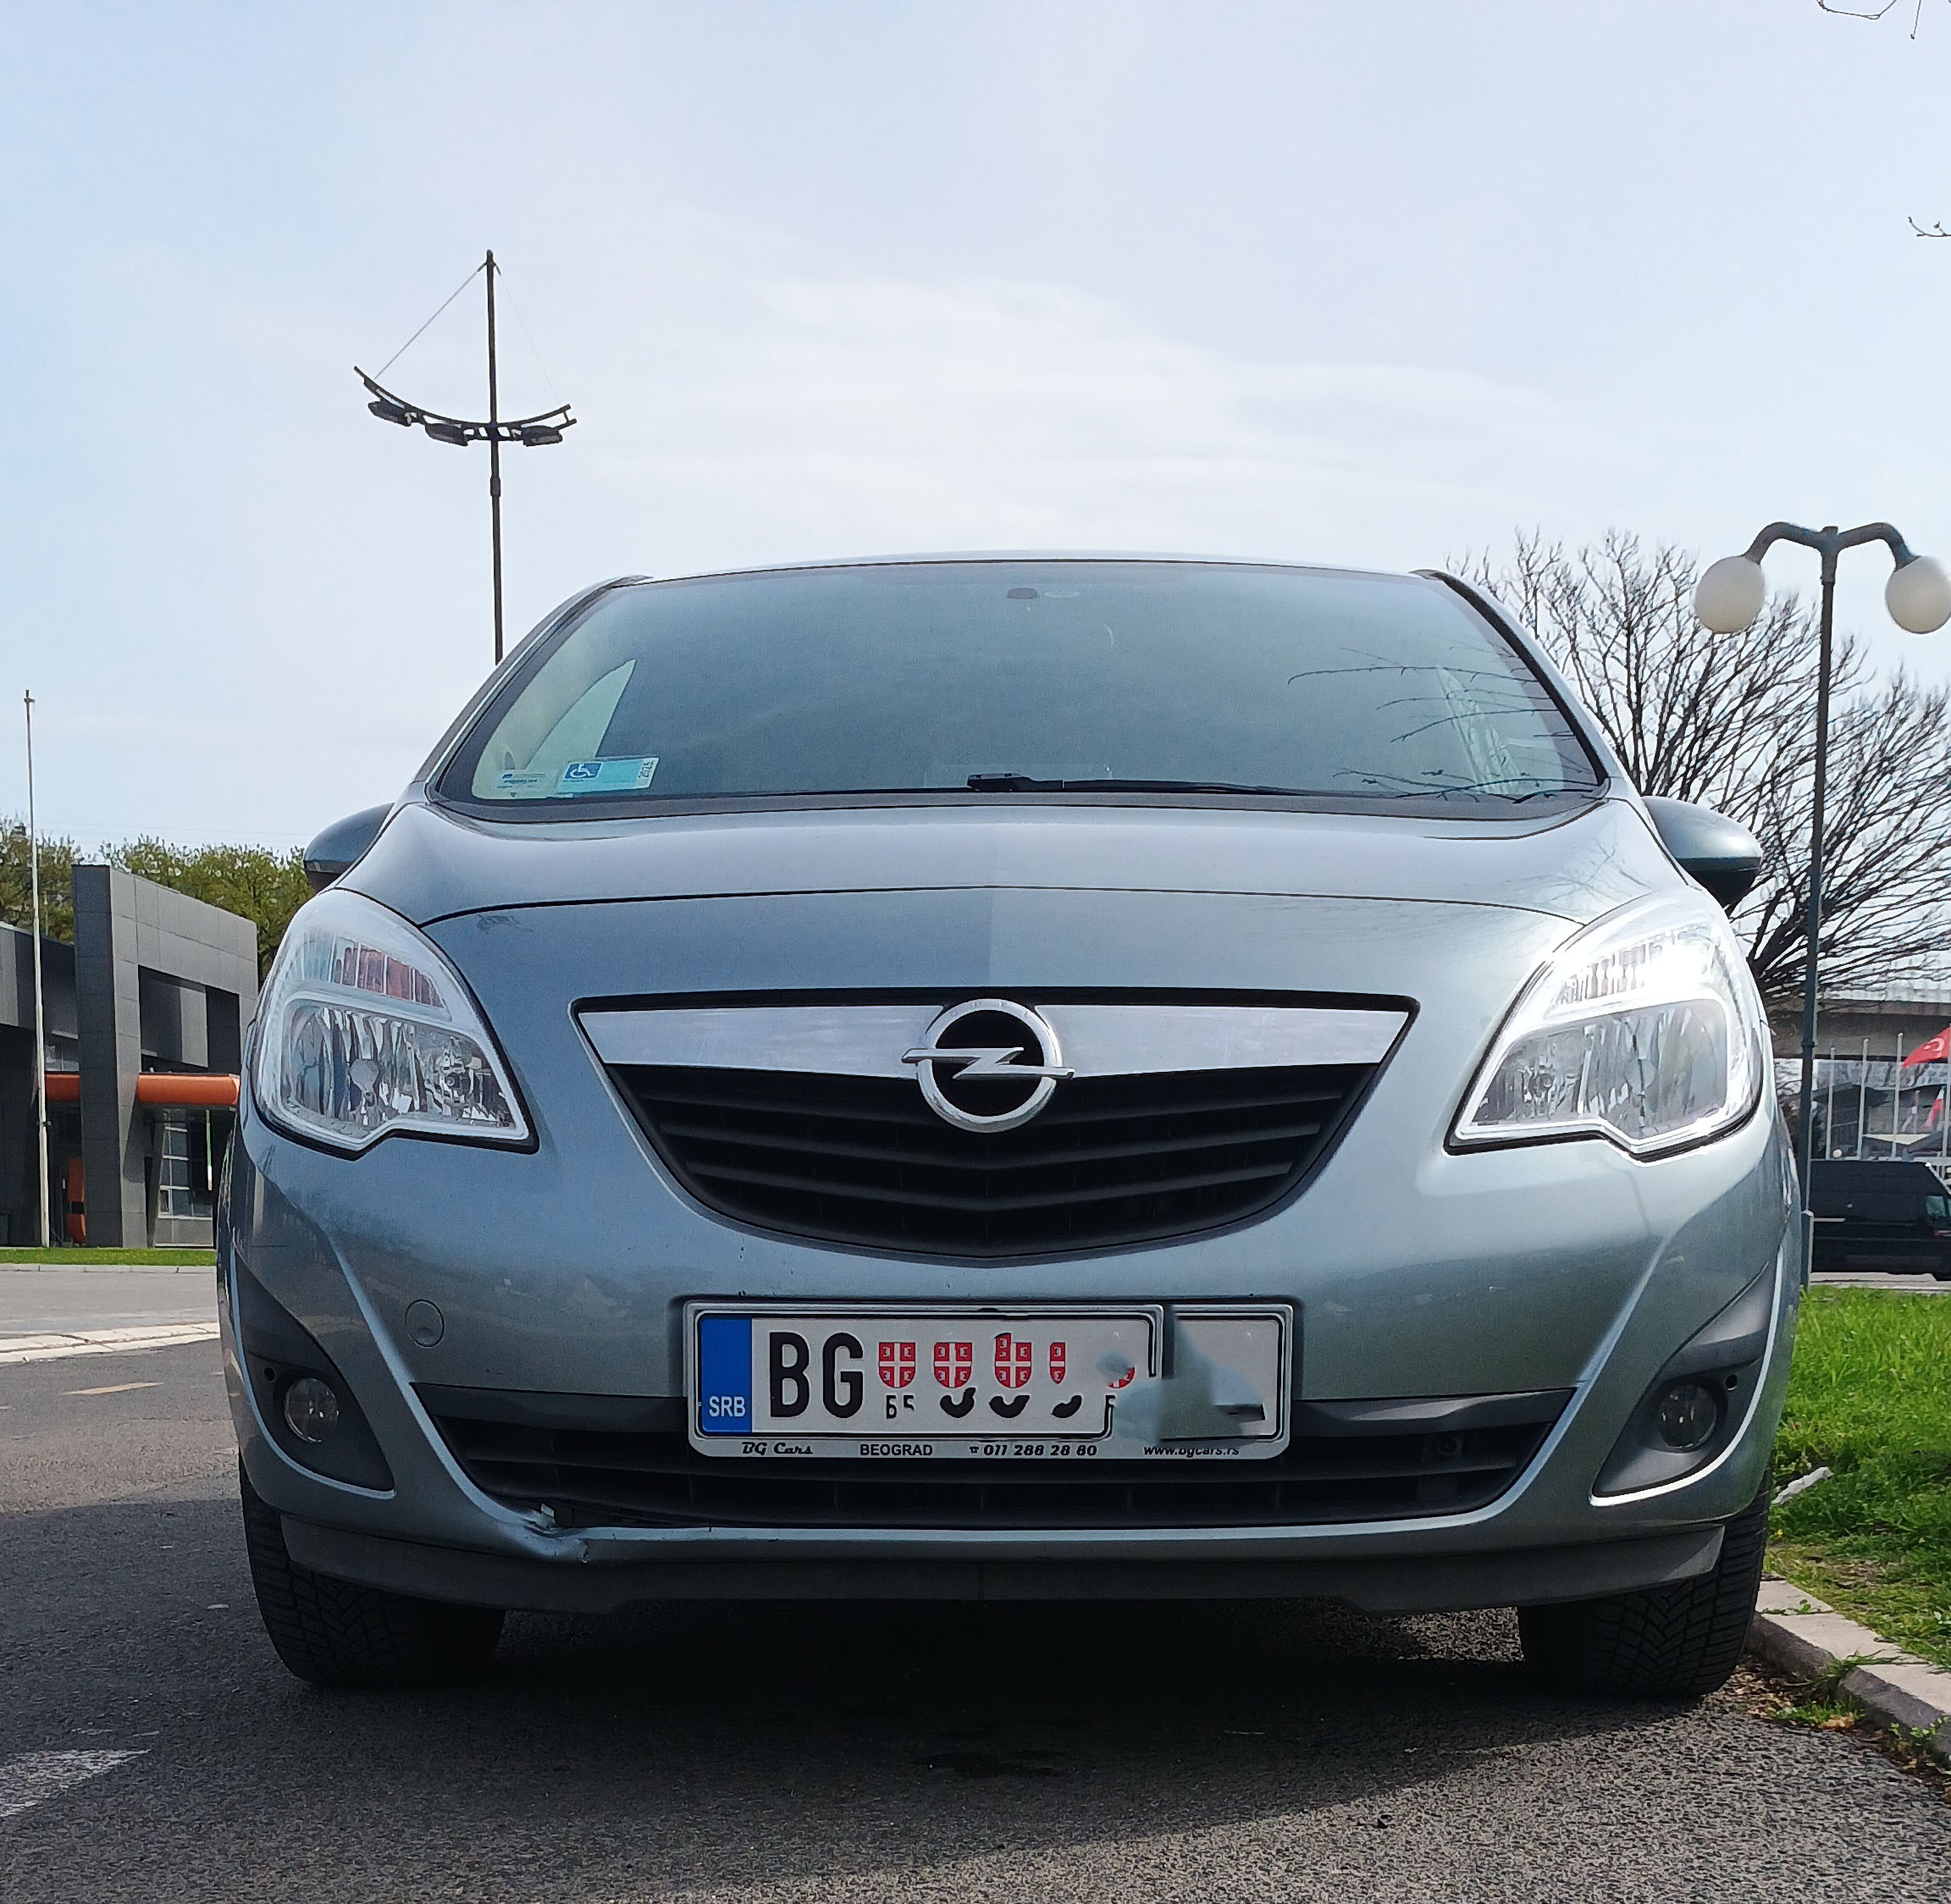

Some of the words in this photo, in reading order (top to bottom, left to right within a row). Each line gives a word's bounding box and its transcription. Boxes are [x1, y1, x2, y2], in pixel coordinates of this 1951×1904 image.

[769, 1332, 864, 1419] BG
[708, 1395, 746, 1417] SRB
[741, 1442, 767, 1456] BG
[773, 1442, 814, 1455] Cars
[859, 1443, 933, 1456] BEOGRAD
[983, 1444, 1009, 1456] 011
[1013, 1444, 1045, 1456] 288
[1049, 1444, 1071, 1456] 28
[1075, 1444, 1097, 1456] 80
